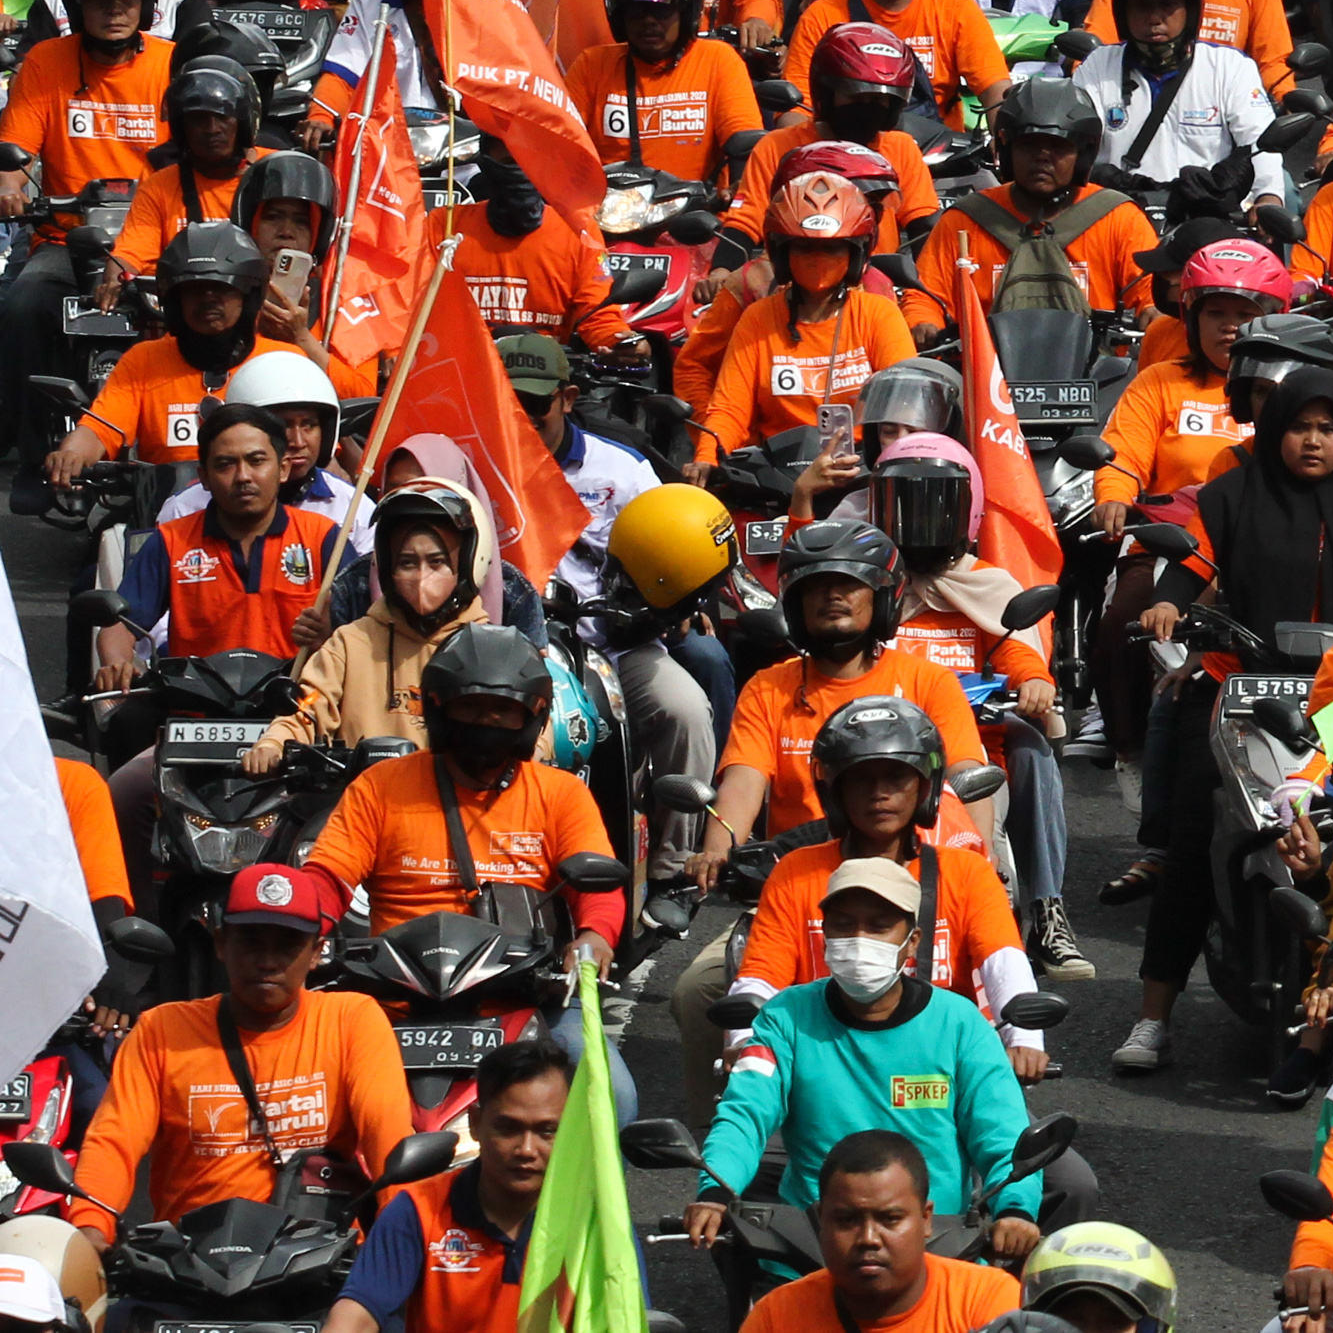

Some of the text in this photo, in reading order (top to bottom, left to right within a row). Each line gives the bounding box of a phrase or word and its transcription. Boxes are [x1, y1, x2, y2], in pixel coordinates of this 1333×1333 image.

[862, 43, 898, 55] INK
[533, 77, 566, 109] NEW
[610, 108, 626, 134] 6
[662, 106, 705, 122] Partai
[72, 113, 87, 134] 6
[117, 117, 156, 132] Partai
[662, 117, 705, 133] Buruh
[117, 127, 157, 141] Buruh
[643, 256, 666, 272] PN
[831, 361, 870, 379] Partai
[777, 369, 796, 392] 6
[1185, 411, 1204, 433] 6
[173, 420, 192, 443] 6
[980, 421, 1029, 460] KAB.
[928, 642, 976, 659] Partai
[1237, 676, 1309, 696] L 5759
[173, 724, 246, 743] N 6853
[797, 736, 814, 748] Are
[368, 751, 399, 759] HONDA
[401, 856, 440, 870] We Are
[422, 947, 460, 958] HONDA
[400, 1029, 453, 1048] 5942
[209, 1245, 253, 1254] HONDA
